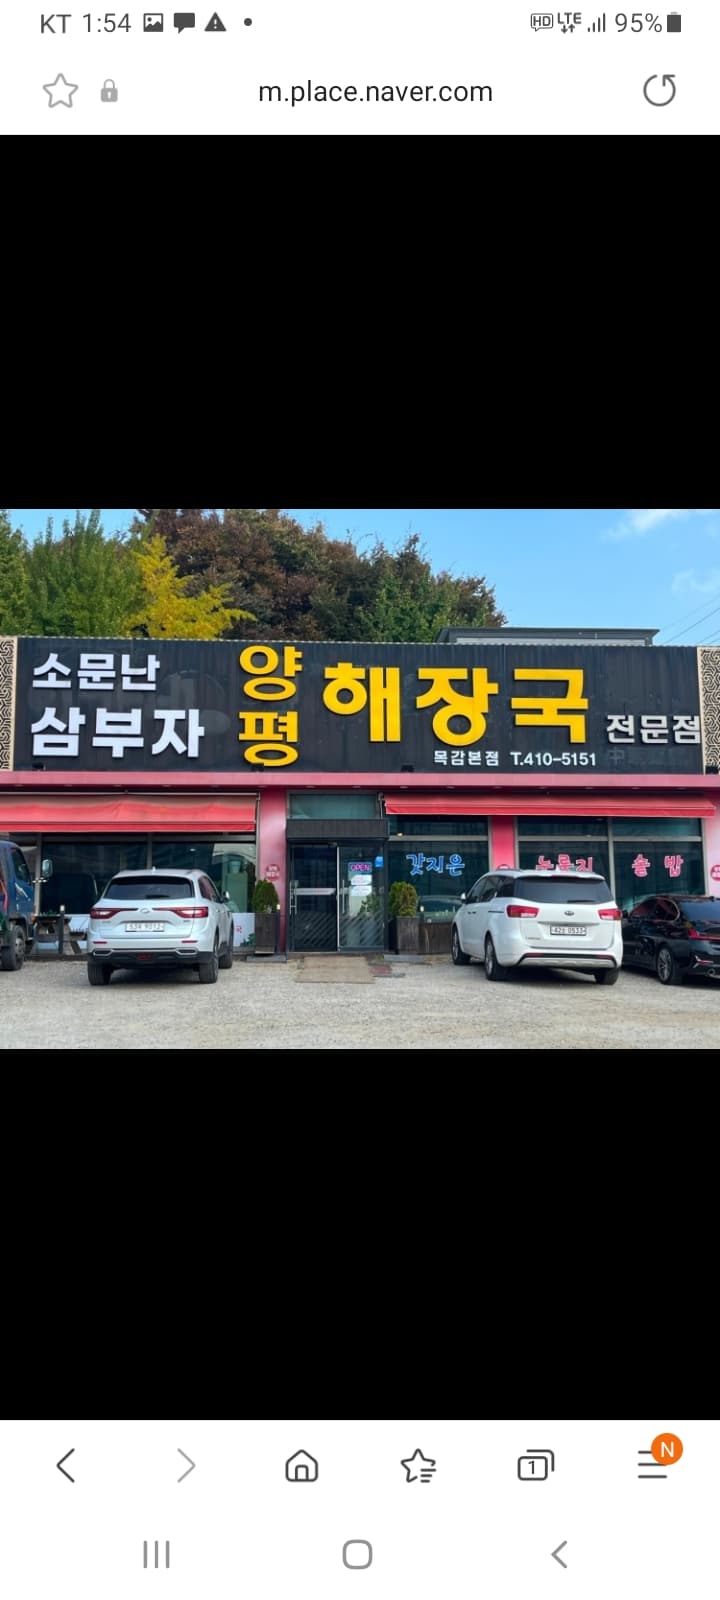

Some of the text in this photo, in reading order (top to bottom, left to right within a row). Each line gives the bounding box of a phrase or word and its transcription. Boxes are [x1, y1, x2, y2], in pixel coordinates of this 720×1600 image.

[40, 13, 132, 33] KT 1:54
[533, 12, 663, 33] HD LTE 95%
[258, 79, 493, 108] m.place.naver.com
[33, 653, 161, 691] 소문난
[239, 645, 303, 767] 양평
[322, 662, 589, 746] 해장국
[31, 707, 205, 758] 삼부자
[606, 714, 701, 744] 전문점
[433, 750, 597, 767] 목감본점 T.410-5151
[350, 863, 370, 872] OPEN
[660, 1441, 675, 1458] N
